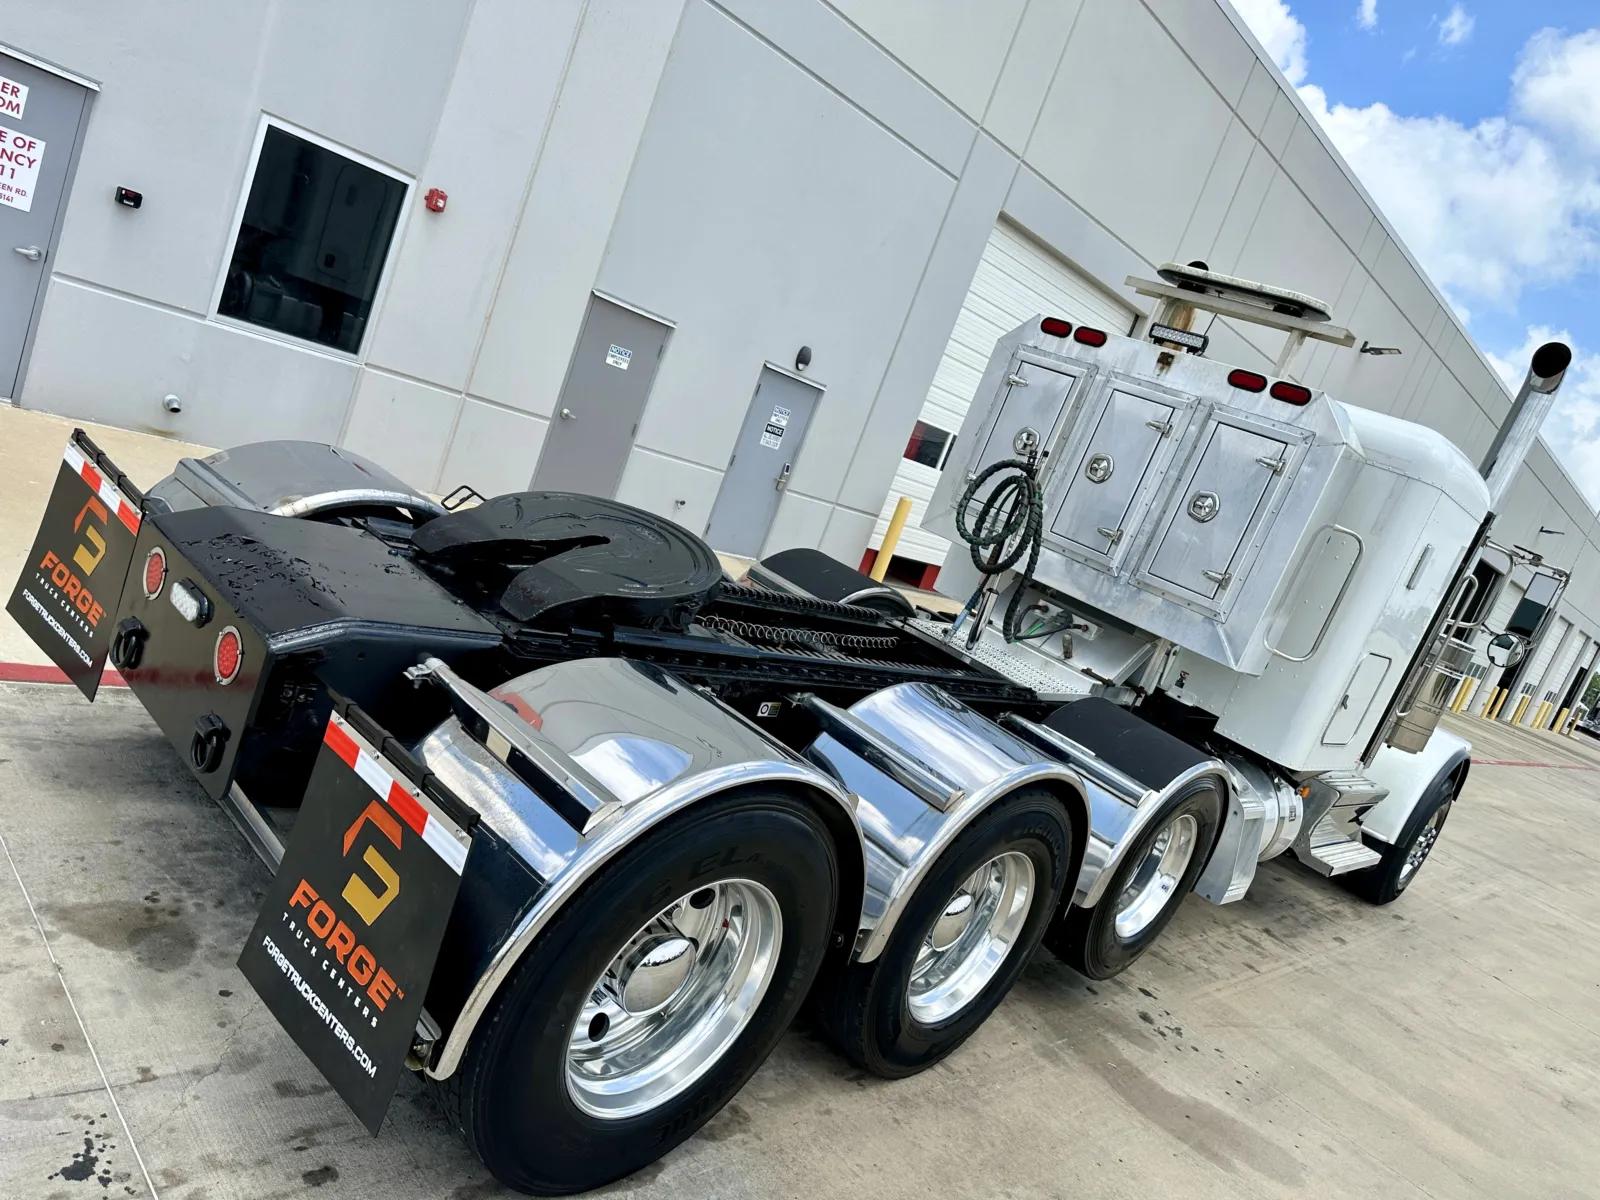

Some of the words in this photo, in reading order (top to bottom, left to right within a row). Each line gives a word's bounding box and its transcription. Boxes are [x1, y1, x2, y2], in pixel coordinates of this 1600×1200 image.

[1, 82, 20, 98] ER
[0, 147, 37, 169] NCY
[13, 136, 37, 151] OF
[35, 572, 58, 599] TRUCK
[60, 600, 93, 638] CENTERS
[40, 550, 103, 627] FORGE
[22, 588, 93, 668] FORGETRUCKCENTERS.COM
[282, 911, 317, 957] TRUCK
[322, 959, 378, 1028] CENTERS
[289, 879, 397, 1012] FORGE
[262, 935, 377, 1077] FORGETRUCKCENTERS.COM
